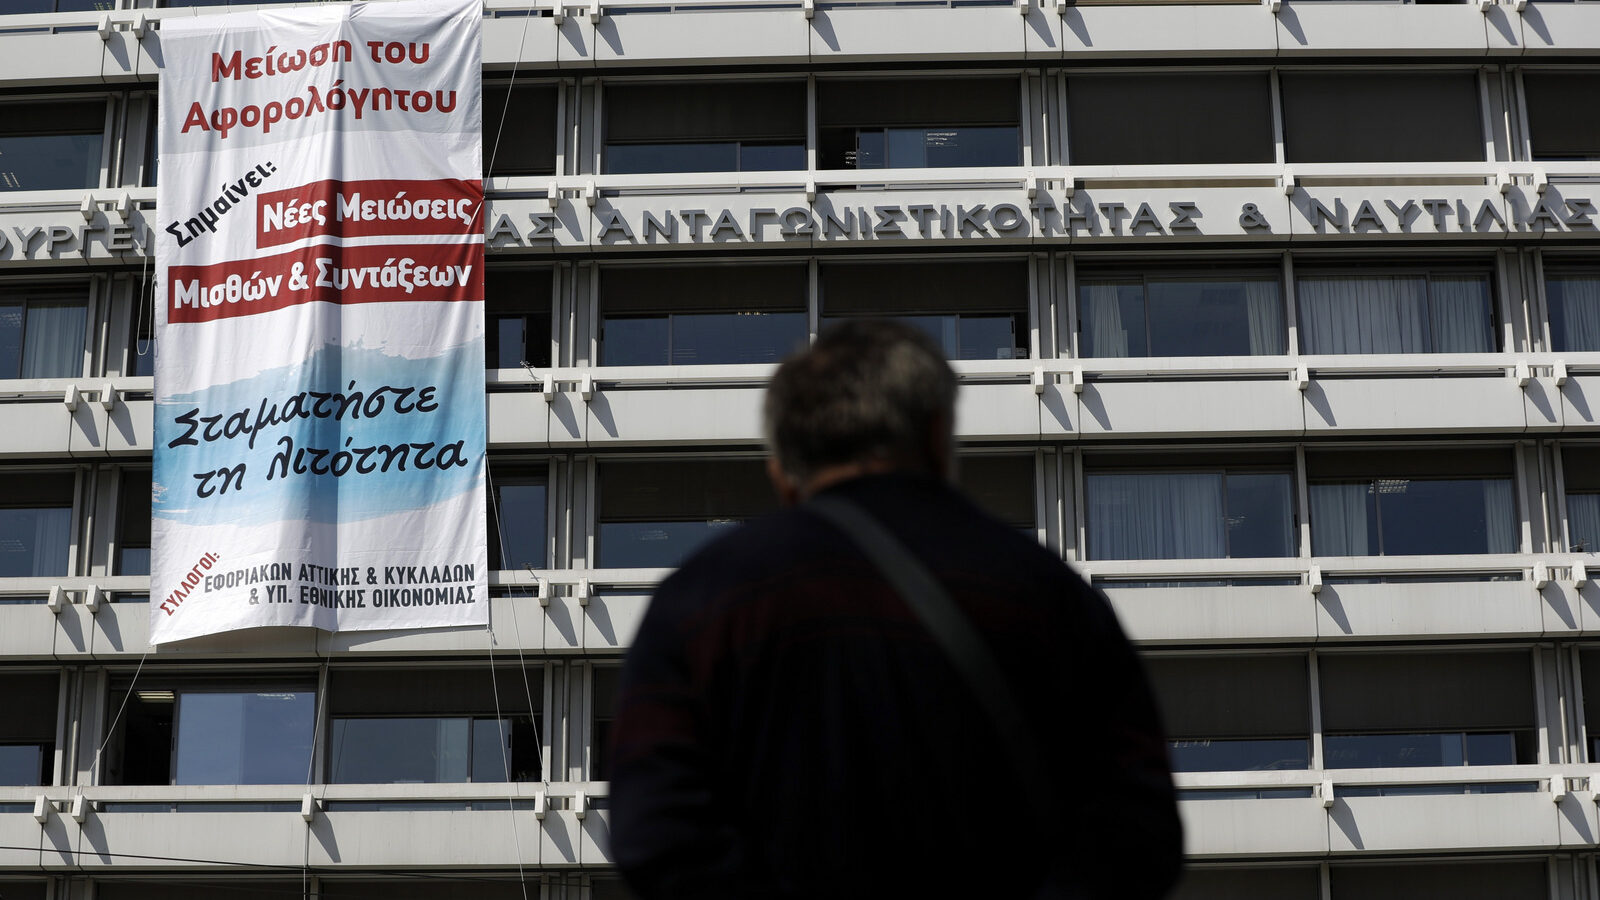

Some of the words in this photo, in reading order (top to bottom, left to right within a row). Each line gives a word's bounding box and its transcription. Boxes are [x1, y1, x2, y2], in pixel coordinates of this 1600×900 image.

[211, 39, 352, 83] Μείωση
[367, 40, 430, 65] του
[181, 80, 457, 139] Αφορολόγητου
[0, 223, 149, 253] ΥΡΓΕΙ
[598, 202, 1197, 239] ΑΝΤΑΓΩΝΙΣΤΙΚΟΤΗΤΑΣ
[1239, 203, 1269, 229] &
[1309, 198, 1593, 230] ΝΑΥΤΙΛΙΑΣ
[165, 161, 277, 248] Σημαίνει:
[263, 197, 327, 233] Νέες
[336, 192, 473, 225] Μειώσεις
[174, 271, 282, 309] Μισθών
[288, 262, 310, 292] &
[315, 258, 473, 294] Συντάξεων
[168, 380, 439, 450] Σταματήστε
[193, 463, 247, 499] τη
[266, 436, 469, 481] λιτότητα
[159, 552, 220, 616] ΣΥΛΛΟΓΟΙ:
[204, 562, 292, 593] ΕΦΟΡΙΑΚΩΝ
[299, 563, 360, 586] ΑΤΤΙΚΗΣ
[366, 566, 377, 585] &
[384, 563, 475, 585] ΚΥΚΛΑΔΩΝ
[248, 587, 260, 606] &
[266, 584, 293, 604] ΥΠ.
[300, 586, 366, 609] ΕΘΝΙΚΗΣ
[373, 585, 476, 608] ΟΙΚΟΝΟΜΙΑΣ
